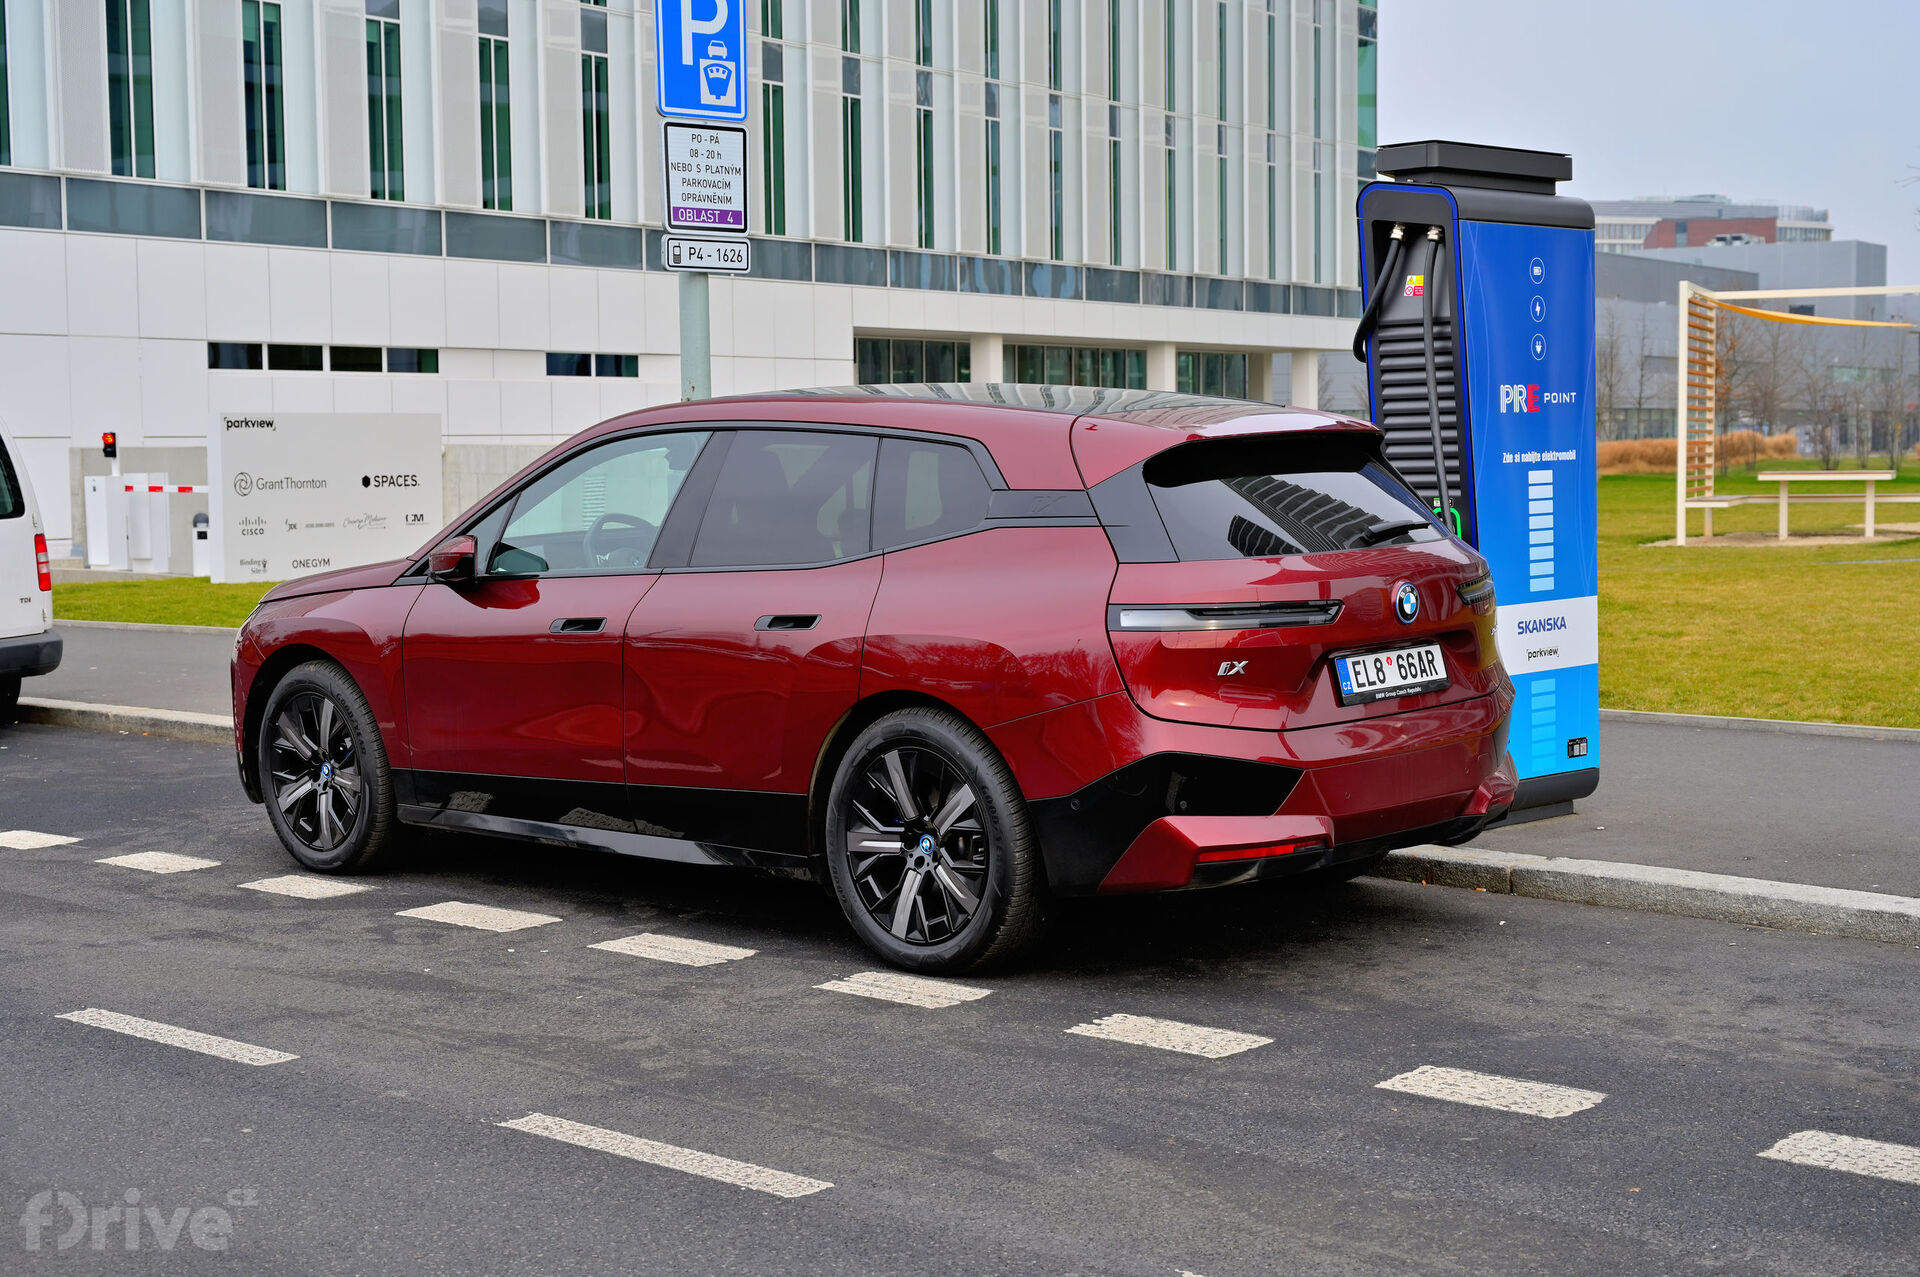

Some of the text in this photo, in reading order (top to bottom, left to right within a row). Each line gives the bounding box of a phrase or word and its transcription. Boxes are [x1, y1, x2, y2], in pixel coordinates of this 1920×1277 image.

[680, 0, 729, 66] P
[691, 133, 703, 144] PO
[709, 132, 720, 145] PÁ
[689, 148, 699, 159] 08
[706, 149, 715, 160] 20
[716, 150, 722, 160] h
[670, 162, 742, 176] NEBO S PLATNÝM
[682, 177, 731, 190] PARKOVACÍM
[681, 191, 732, 205] OPRÁVNĚNÍM
[678, 208, 734, 224] OBLAST 4
[688, 246, 704, 261] P4
[716, 248, 743, 263] 1626
[1500, 384, 1577, 414] PRE POINT
[226, 417, 275, 431] parkview
[292, 558, 330, 569] ONEGYM
[1517, 616, 1567, 635] SKANSKA
[1527, 647, 1559, 661] parkview
[1351, 649, 1439, 689] EL8 66AR
[1342, 681, 1352, 691] CZ
